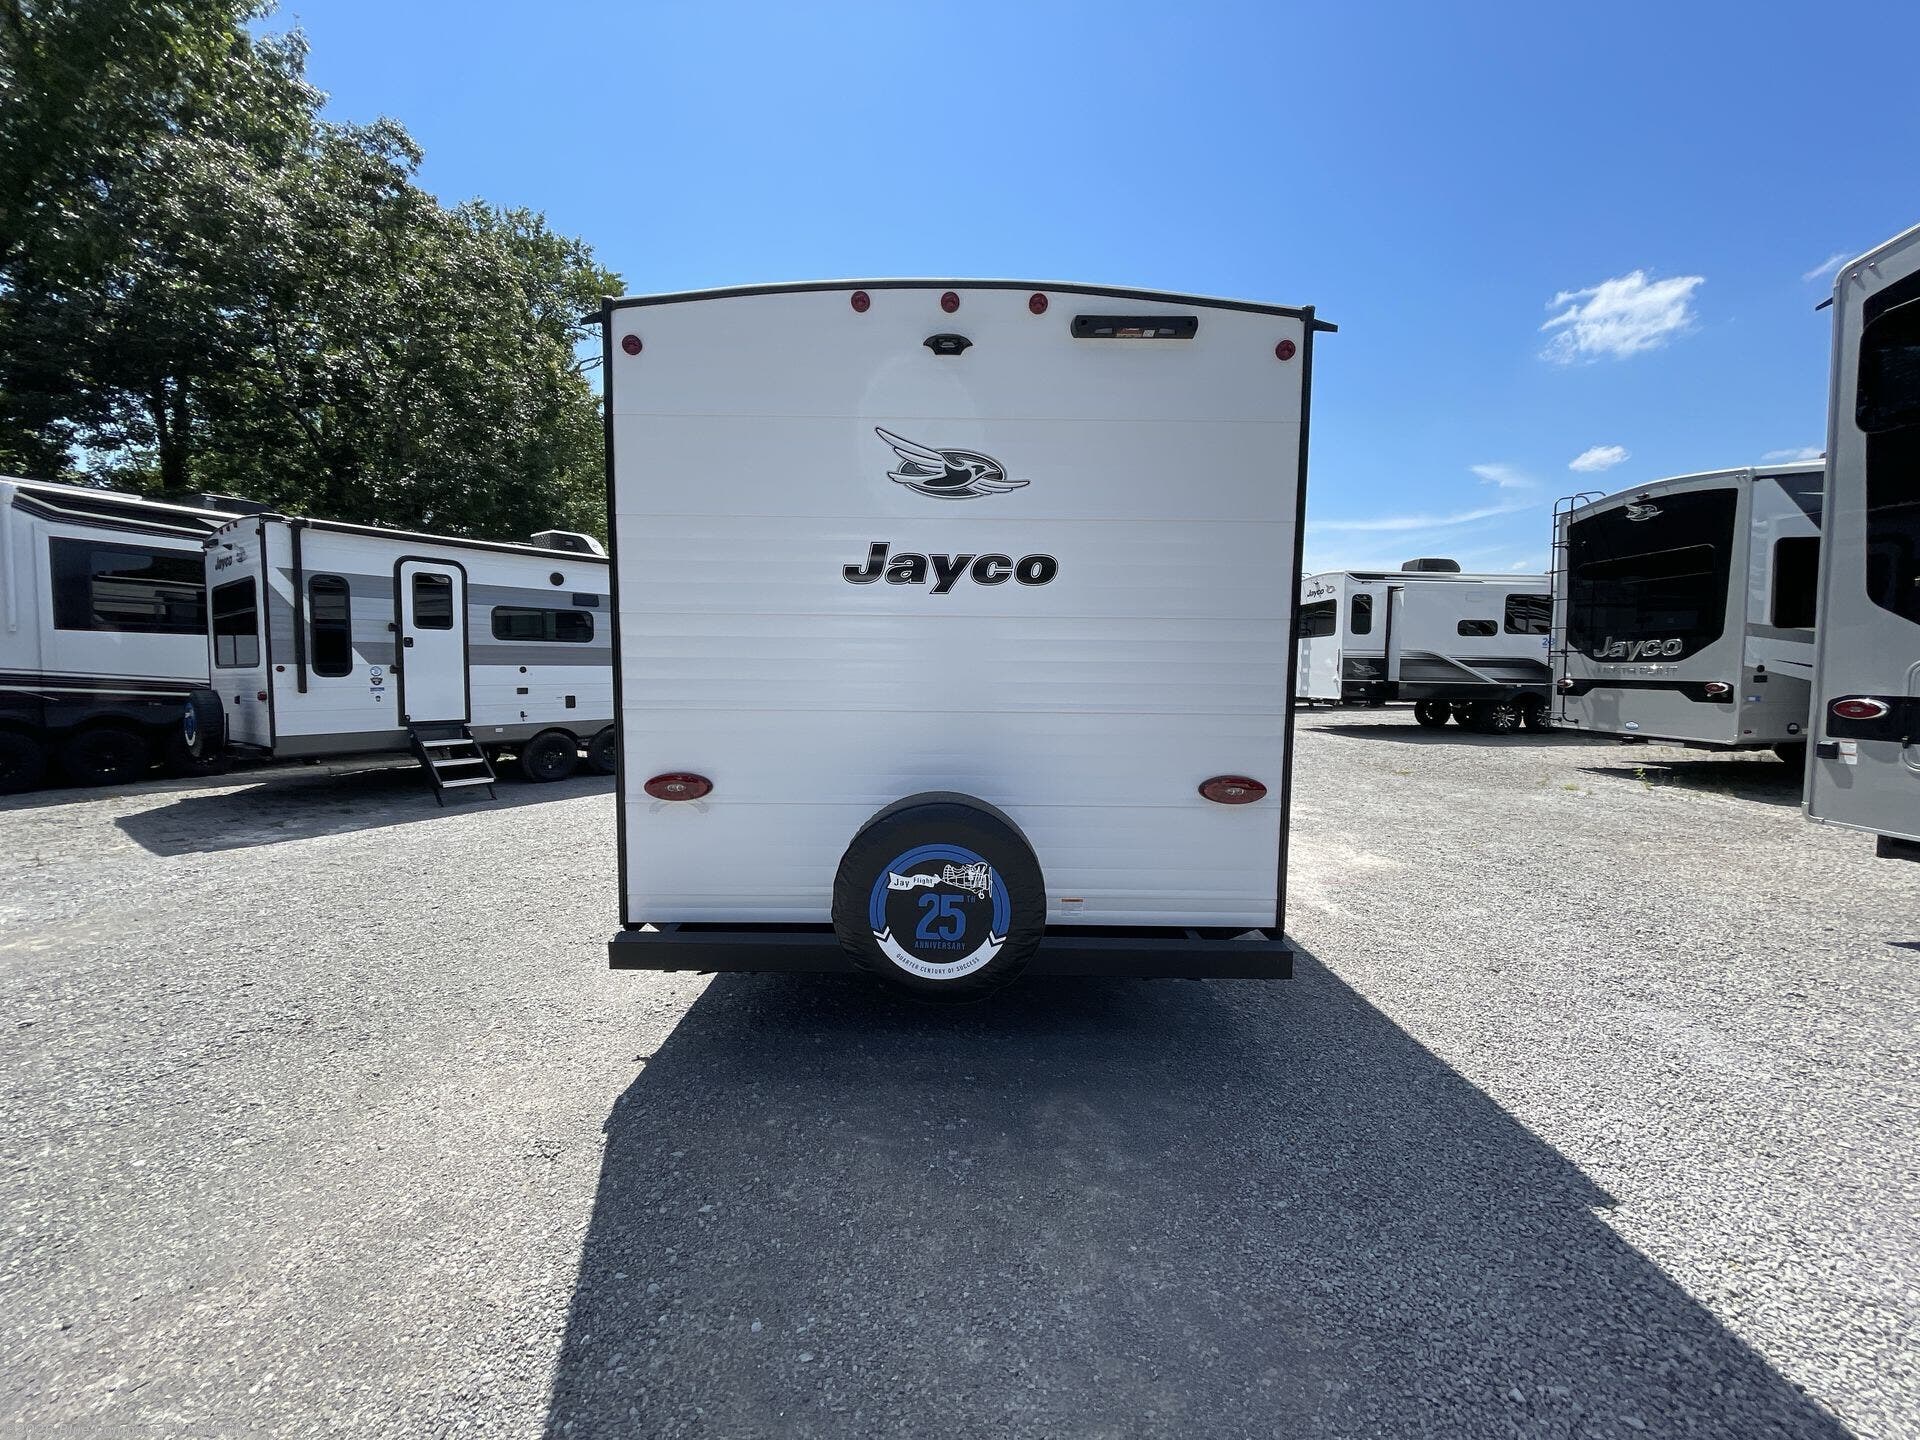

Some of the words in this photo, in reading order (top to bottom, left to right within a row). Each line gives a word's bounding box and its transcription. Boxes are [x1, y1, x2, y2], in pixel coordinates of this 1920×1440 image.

[842, 541, 1059, 594] Jayco
[1593, 636, 1683, 661] Jayco
[894, 878, 910, 888] Jay
[913, 876, 933, 885] Flight
[916, 893, 967, 942] 25
[966, 895, 976, 903] TH
[914, 941, 967, 951] ANNIVERSARY
[896, 953, 919, 970] QUARTER
[920, 965, 946, 975] CENTURY
[947, 966, 955, 974] OF
[956, 957, 980, 972] SUCCESS
